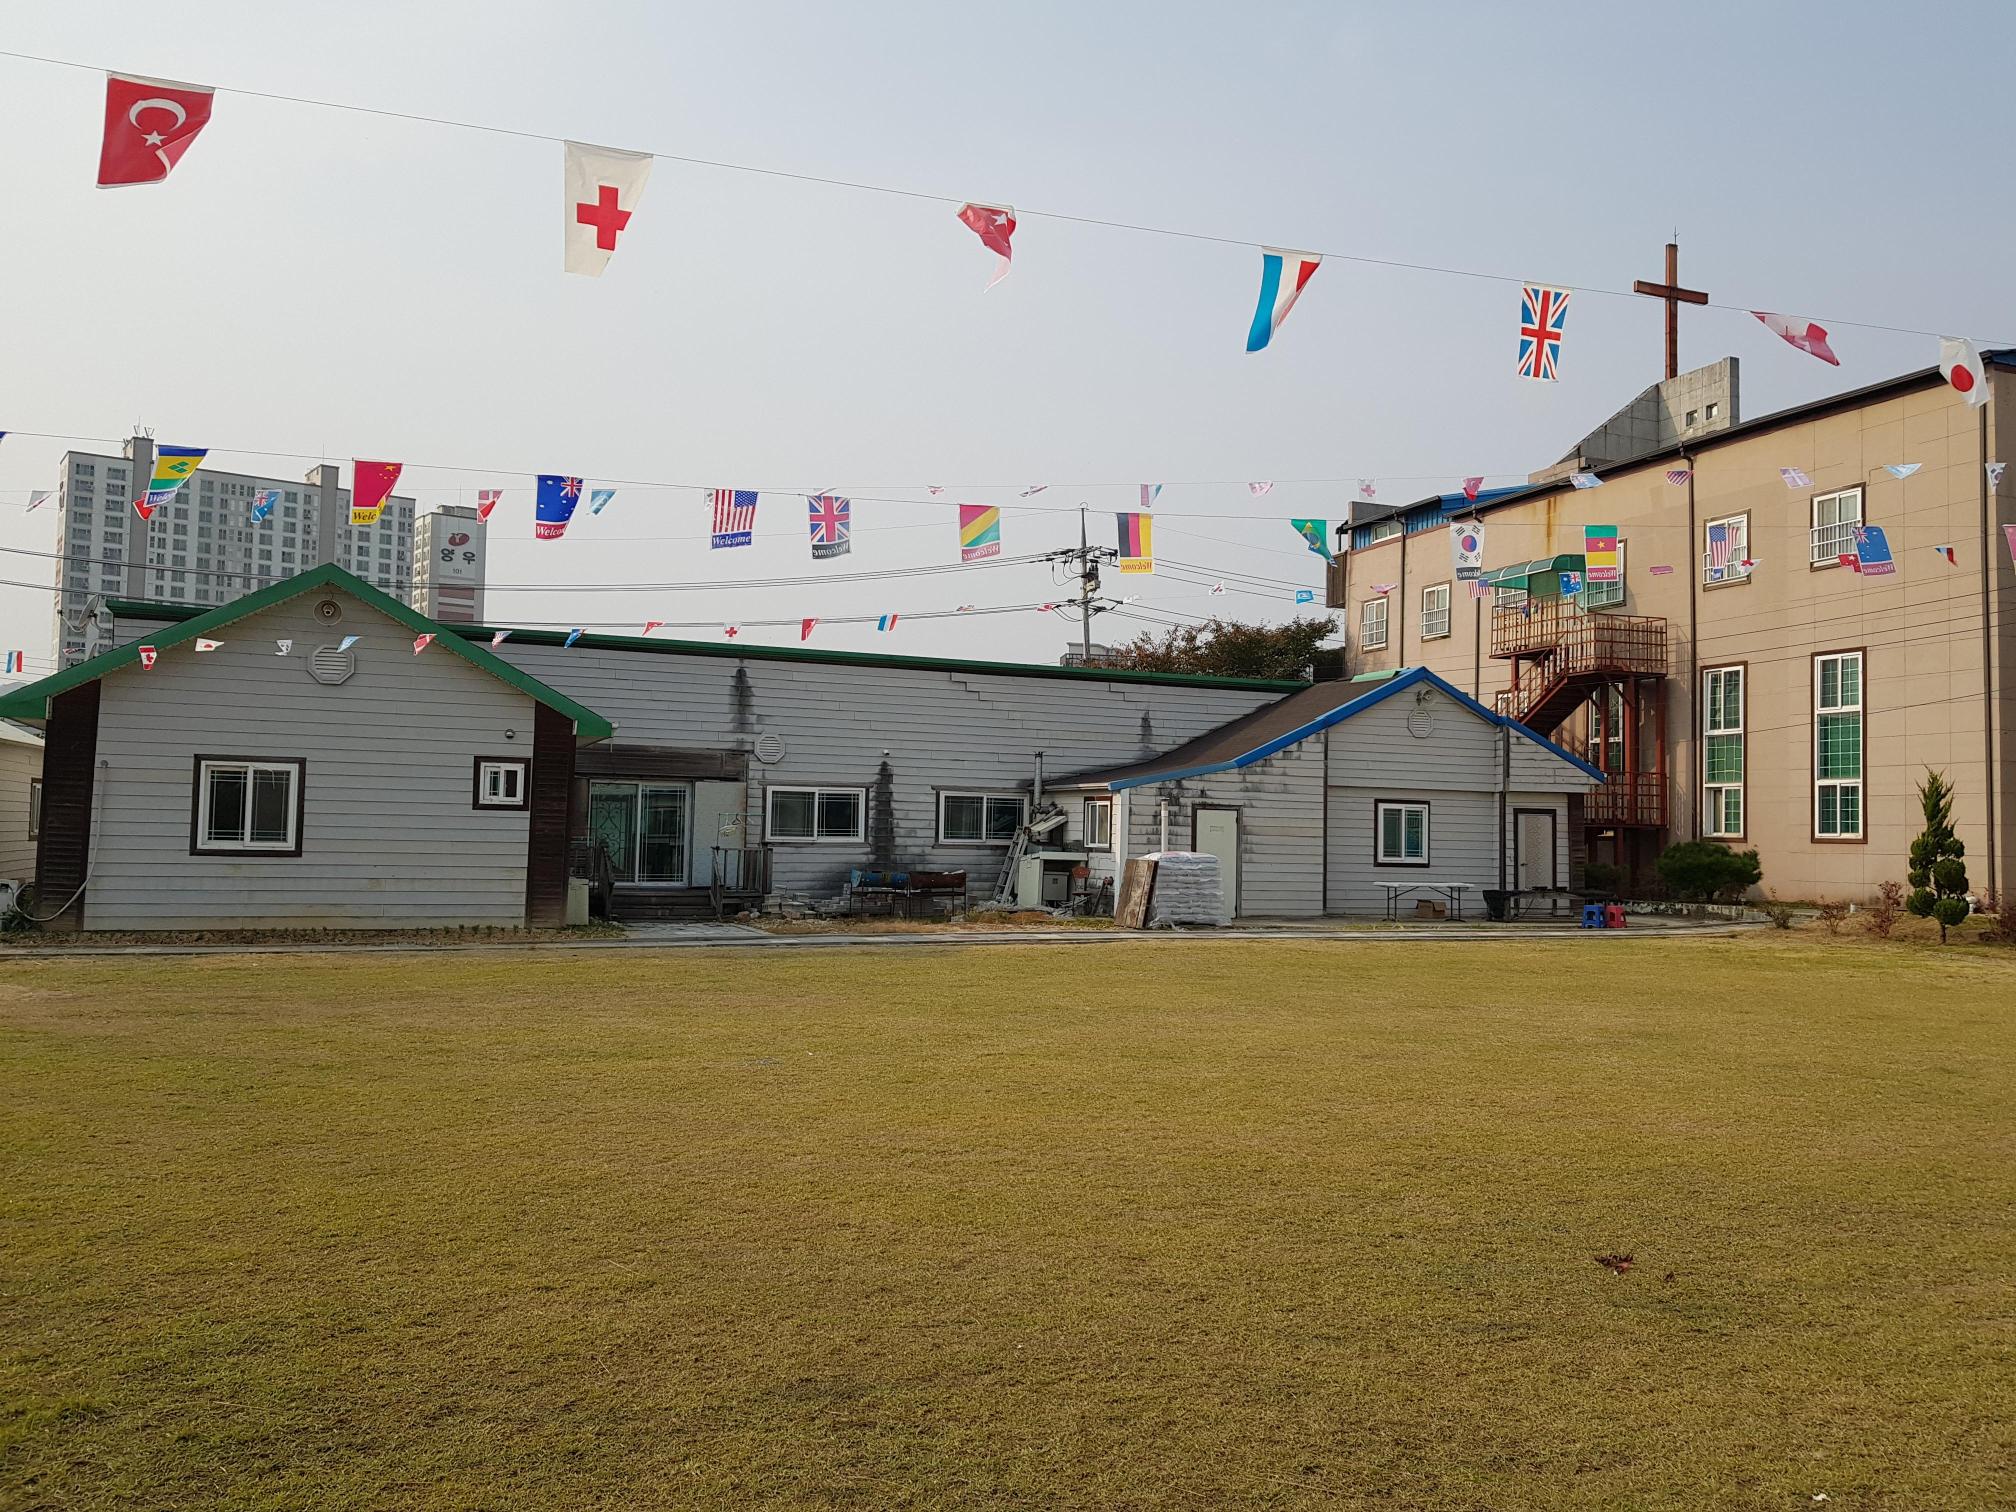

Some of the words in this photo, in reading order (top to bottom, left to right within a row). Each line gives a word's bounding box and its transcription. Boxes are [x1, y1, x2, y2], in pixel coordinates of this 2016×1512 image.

[354, 512, 377, 520] Welc
[536, 526, 564, 536] Welco
[712, 536, 750, 545] Welcome
